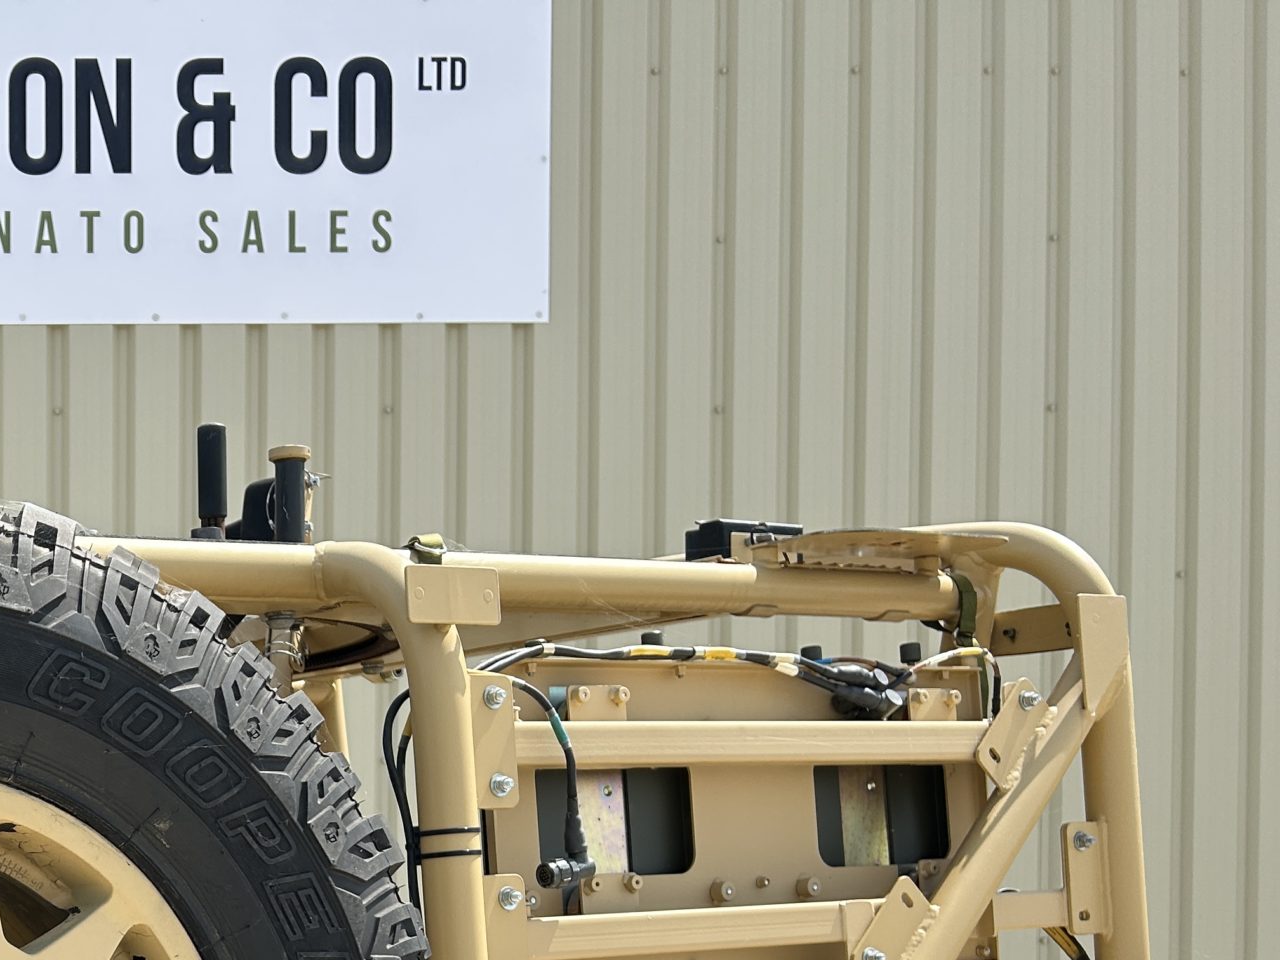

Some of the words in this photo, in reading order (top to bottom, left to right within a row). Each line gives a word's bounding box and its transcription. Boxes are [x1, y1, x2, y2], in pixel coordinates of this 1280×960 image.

[177, 58, 235, 175] &
[274, 57, 392, 174] CO
[418, 57, 466, 91] LTD
[199, 210, 391, 253] SALES
